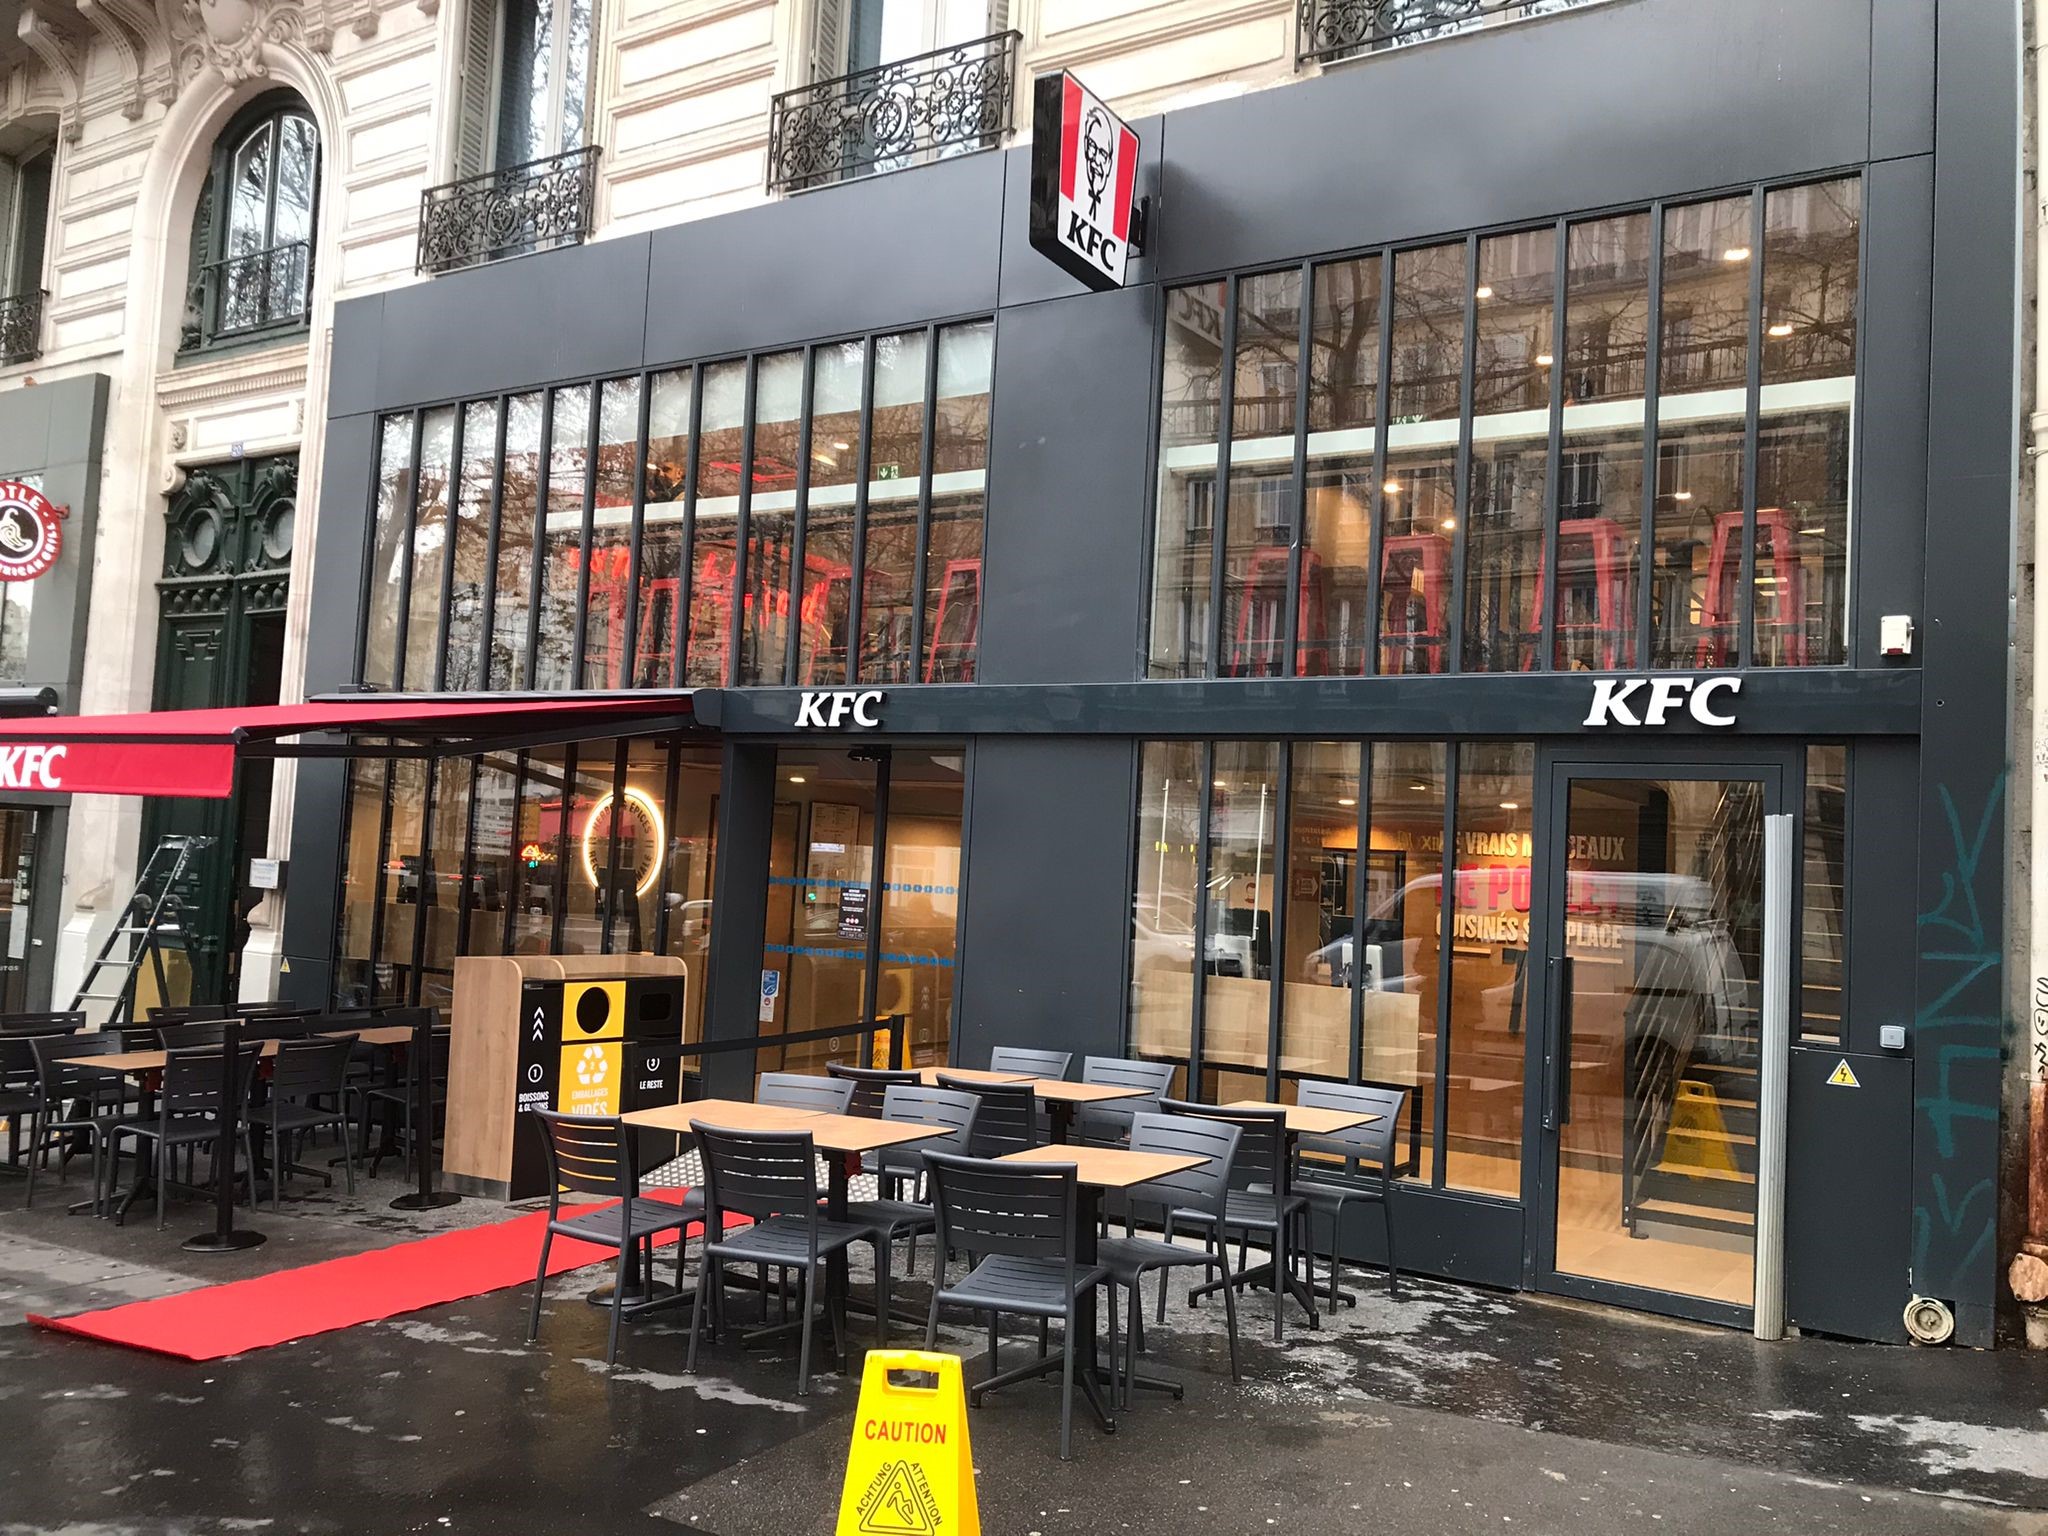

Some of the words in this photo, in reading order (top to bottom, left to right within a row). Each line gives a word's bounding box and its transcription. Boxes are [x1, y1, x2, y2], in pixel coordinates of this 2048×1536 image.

[1066, 209, 1117, 272] KFC
[793, 690, 883, 727] KFC
[1582, 676, 1742, 727] KFC
[0, 745, 67, 789] KFC
[592, 803, 613, 830] HERB
[1465, 831, 1518, 857] VRAIS
[1521, 833, 1625, 861] MCEAUX
[1566, 920, 1623, 949] PLACE
[518, 1091, 550, 1103] BOISSONS
[639, 1080, 647, 1090] LE
[647, 1079, 664, 1089] RESTE
[571, 1098, 609, 1115] VIDÉS
[865, 1419, 947, 1445] CAUTION
[856, 1461, 892, 1516] ACHTUNG
[911, 1462, 944, 1527] ATTENTION
